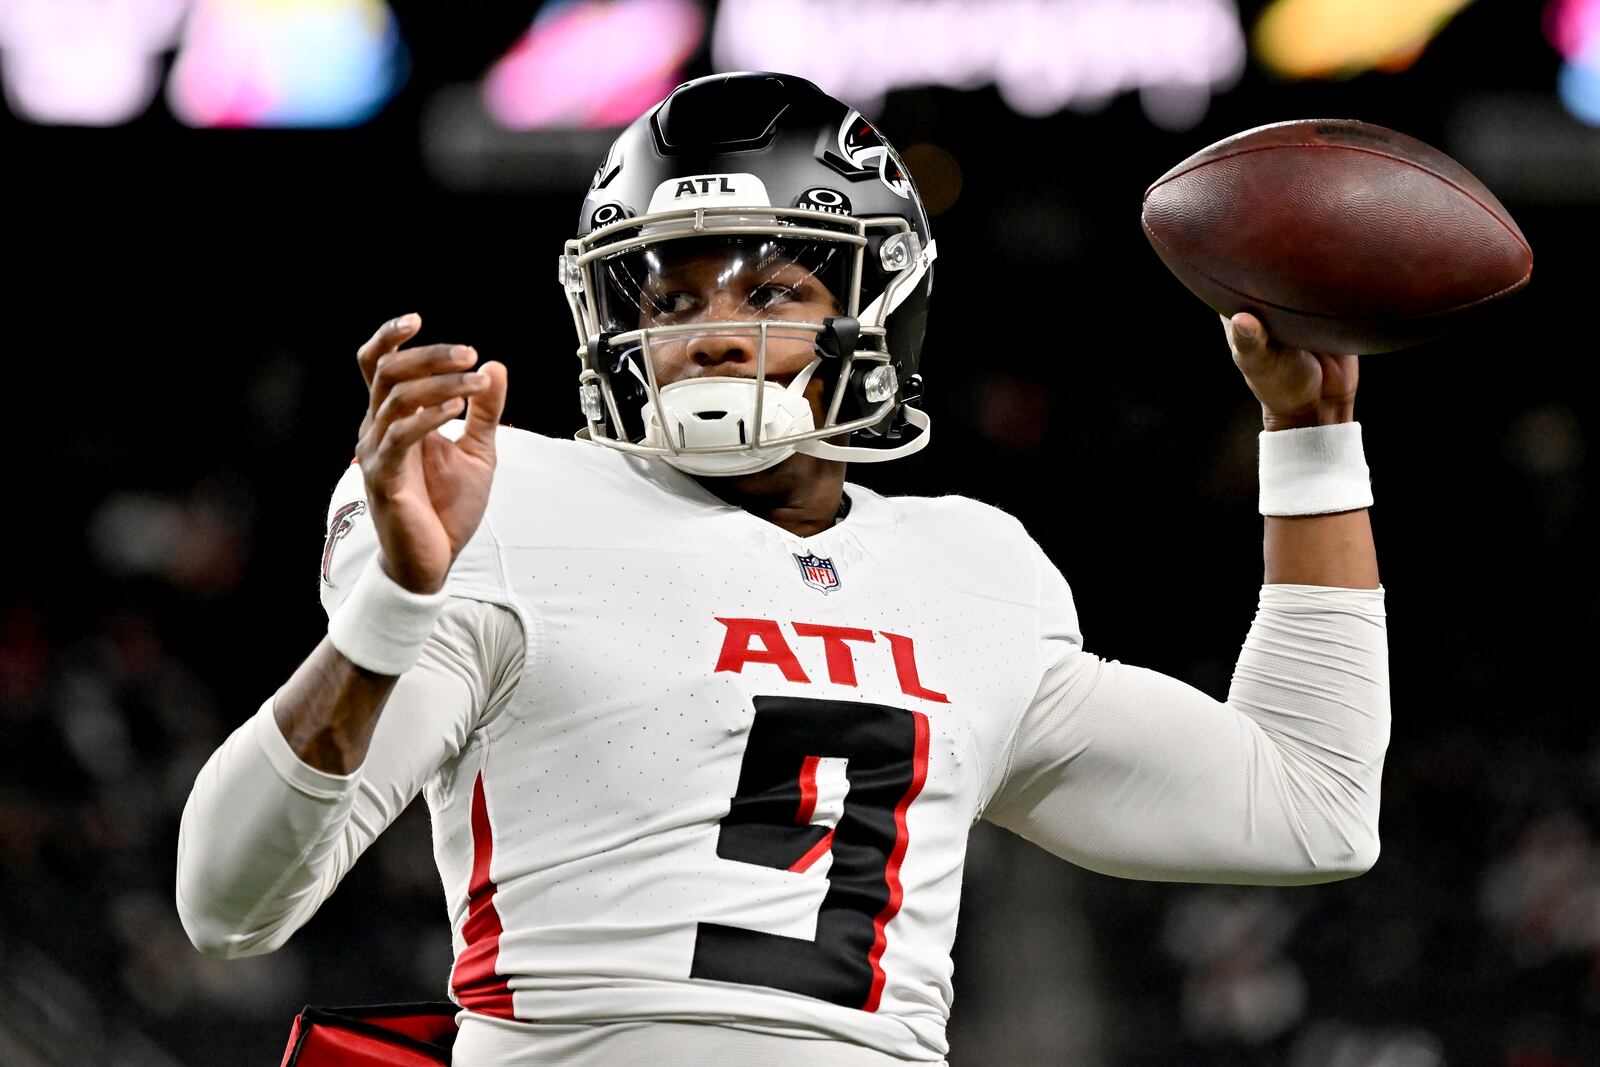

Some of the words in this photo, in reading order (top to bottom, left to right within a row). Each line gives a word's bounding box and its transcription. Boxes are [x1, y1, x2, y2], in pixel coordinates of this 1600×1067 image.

[675, 177, 736, 198] ATL
[806, 565, 836, 585] NFL
[714, 616, 952, 704] ATL
[689, 694, 930, 1013] 9
